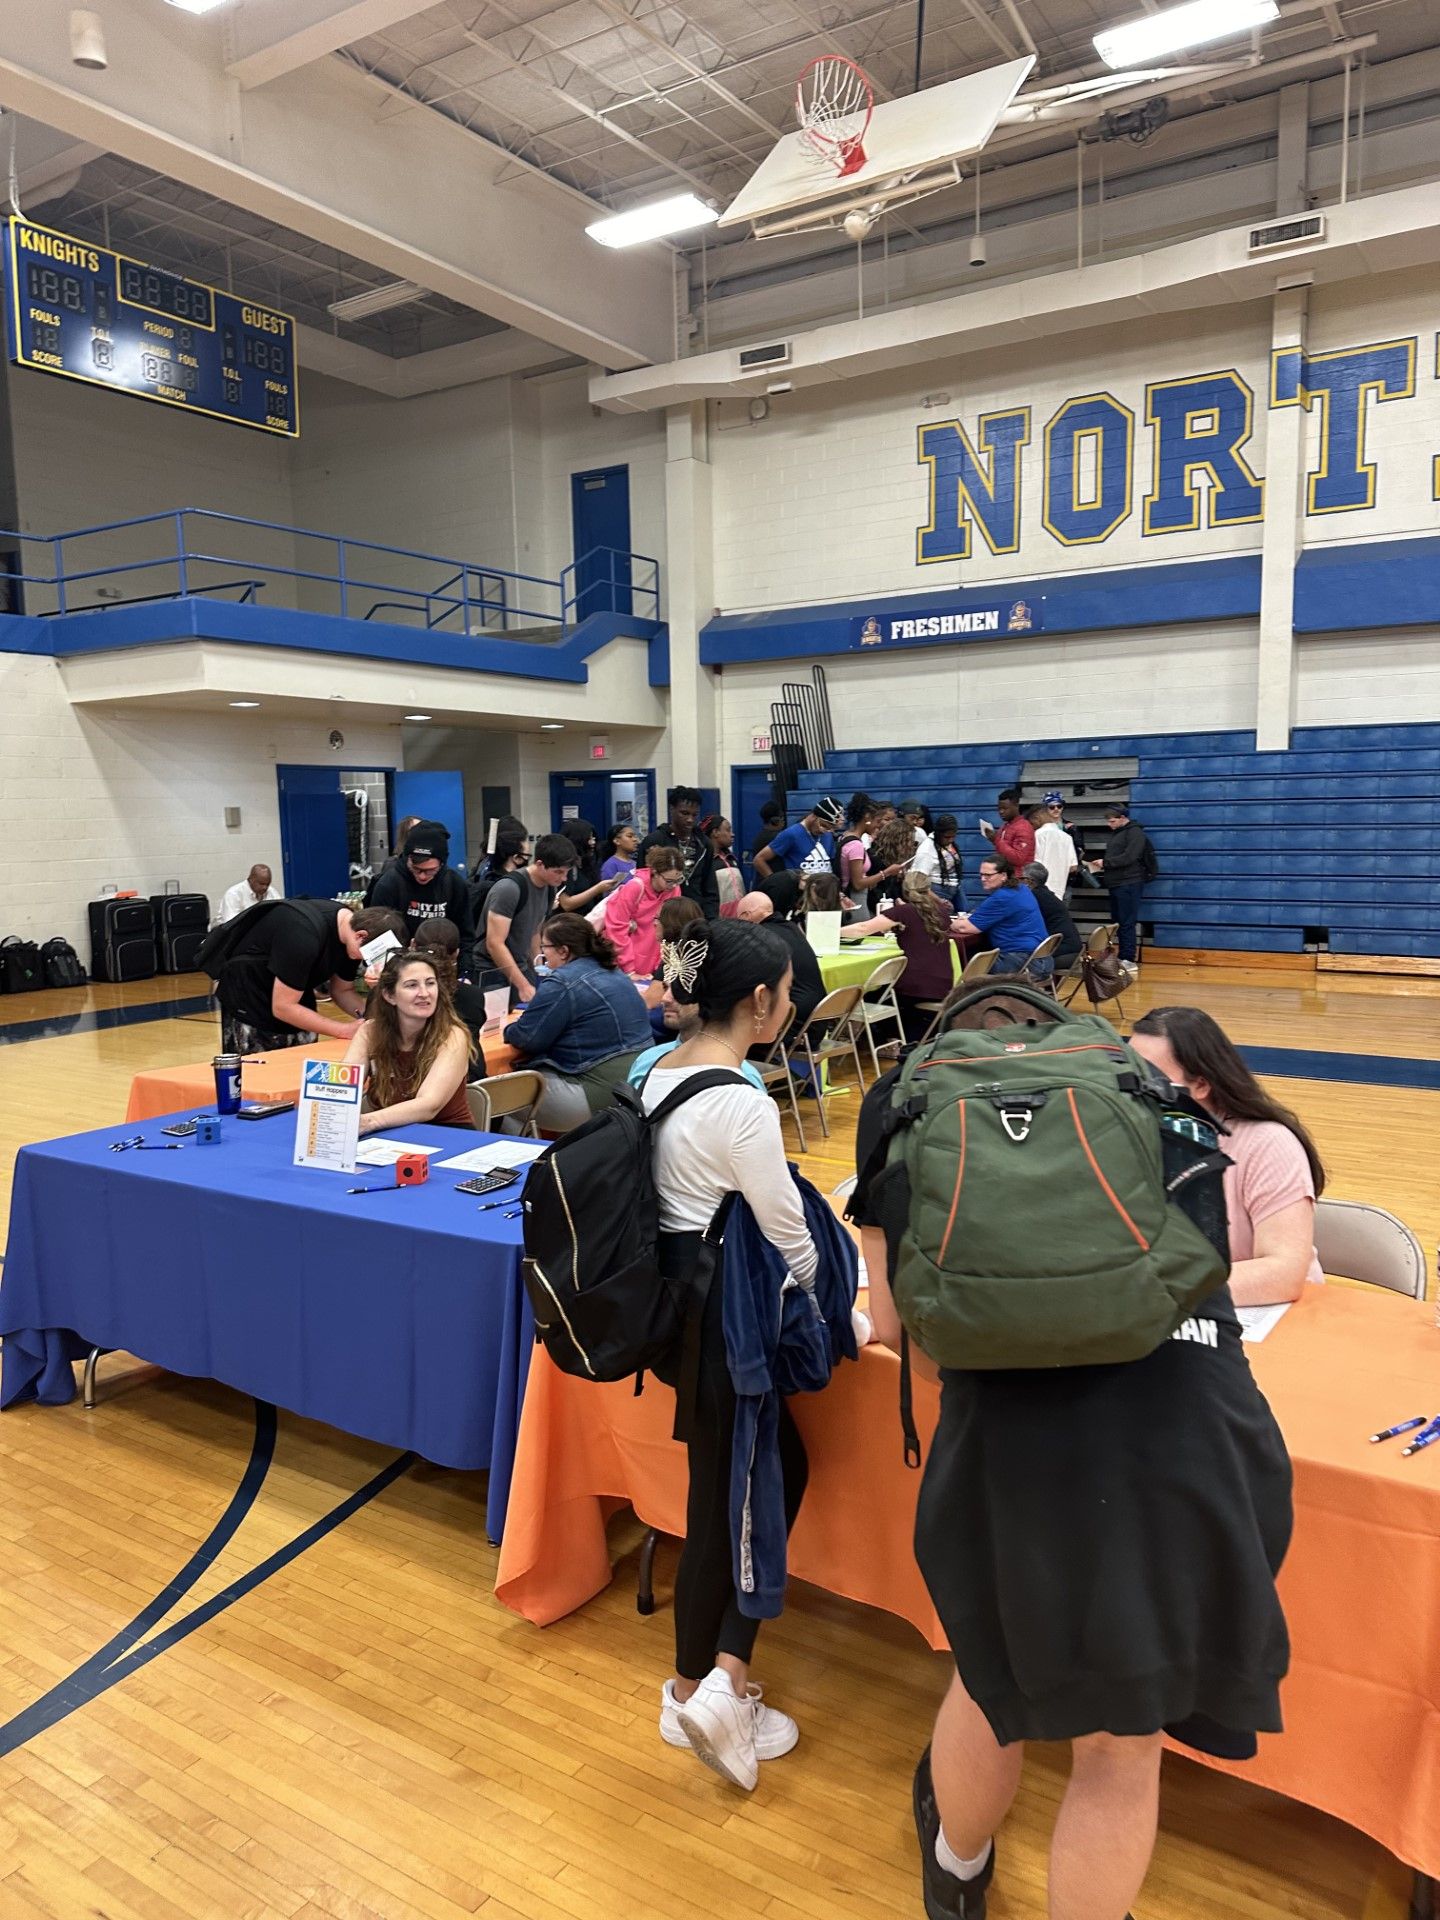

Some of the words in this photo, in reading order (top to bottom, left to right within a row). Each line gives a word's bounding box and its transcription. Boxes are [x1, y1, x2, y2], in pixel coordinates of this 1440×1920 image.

[19, 227, 100, 272] KNIGHTS
[29, 308, 61, 326] FOULS
[241, 306, 287, 336] GUEST
[143, 320, 174, 339] PERIOD
[32, 349, 63, 368] SCORE
[177, 353, 200, 368] FOUL
[157, 384, 187, 401] MATCH
[264, 380, 289, 395] FOULS
[266, 415, 290, 429] SCORE
[916, 332, 1440, 566] NORT
[890, 610, 1000, 640] FRESHMEN
